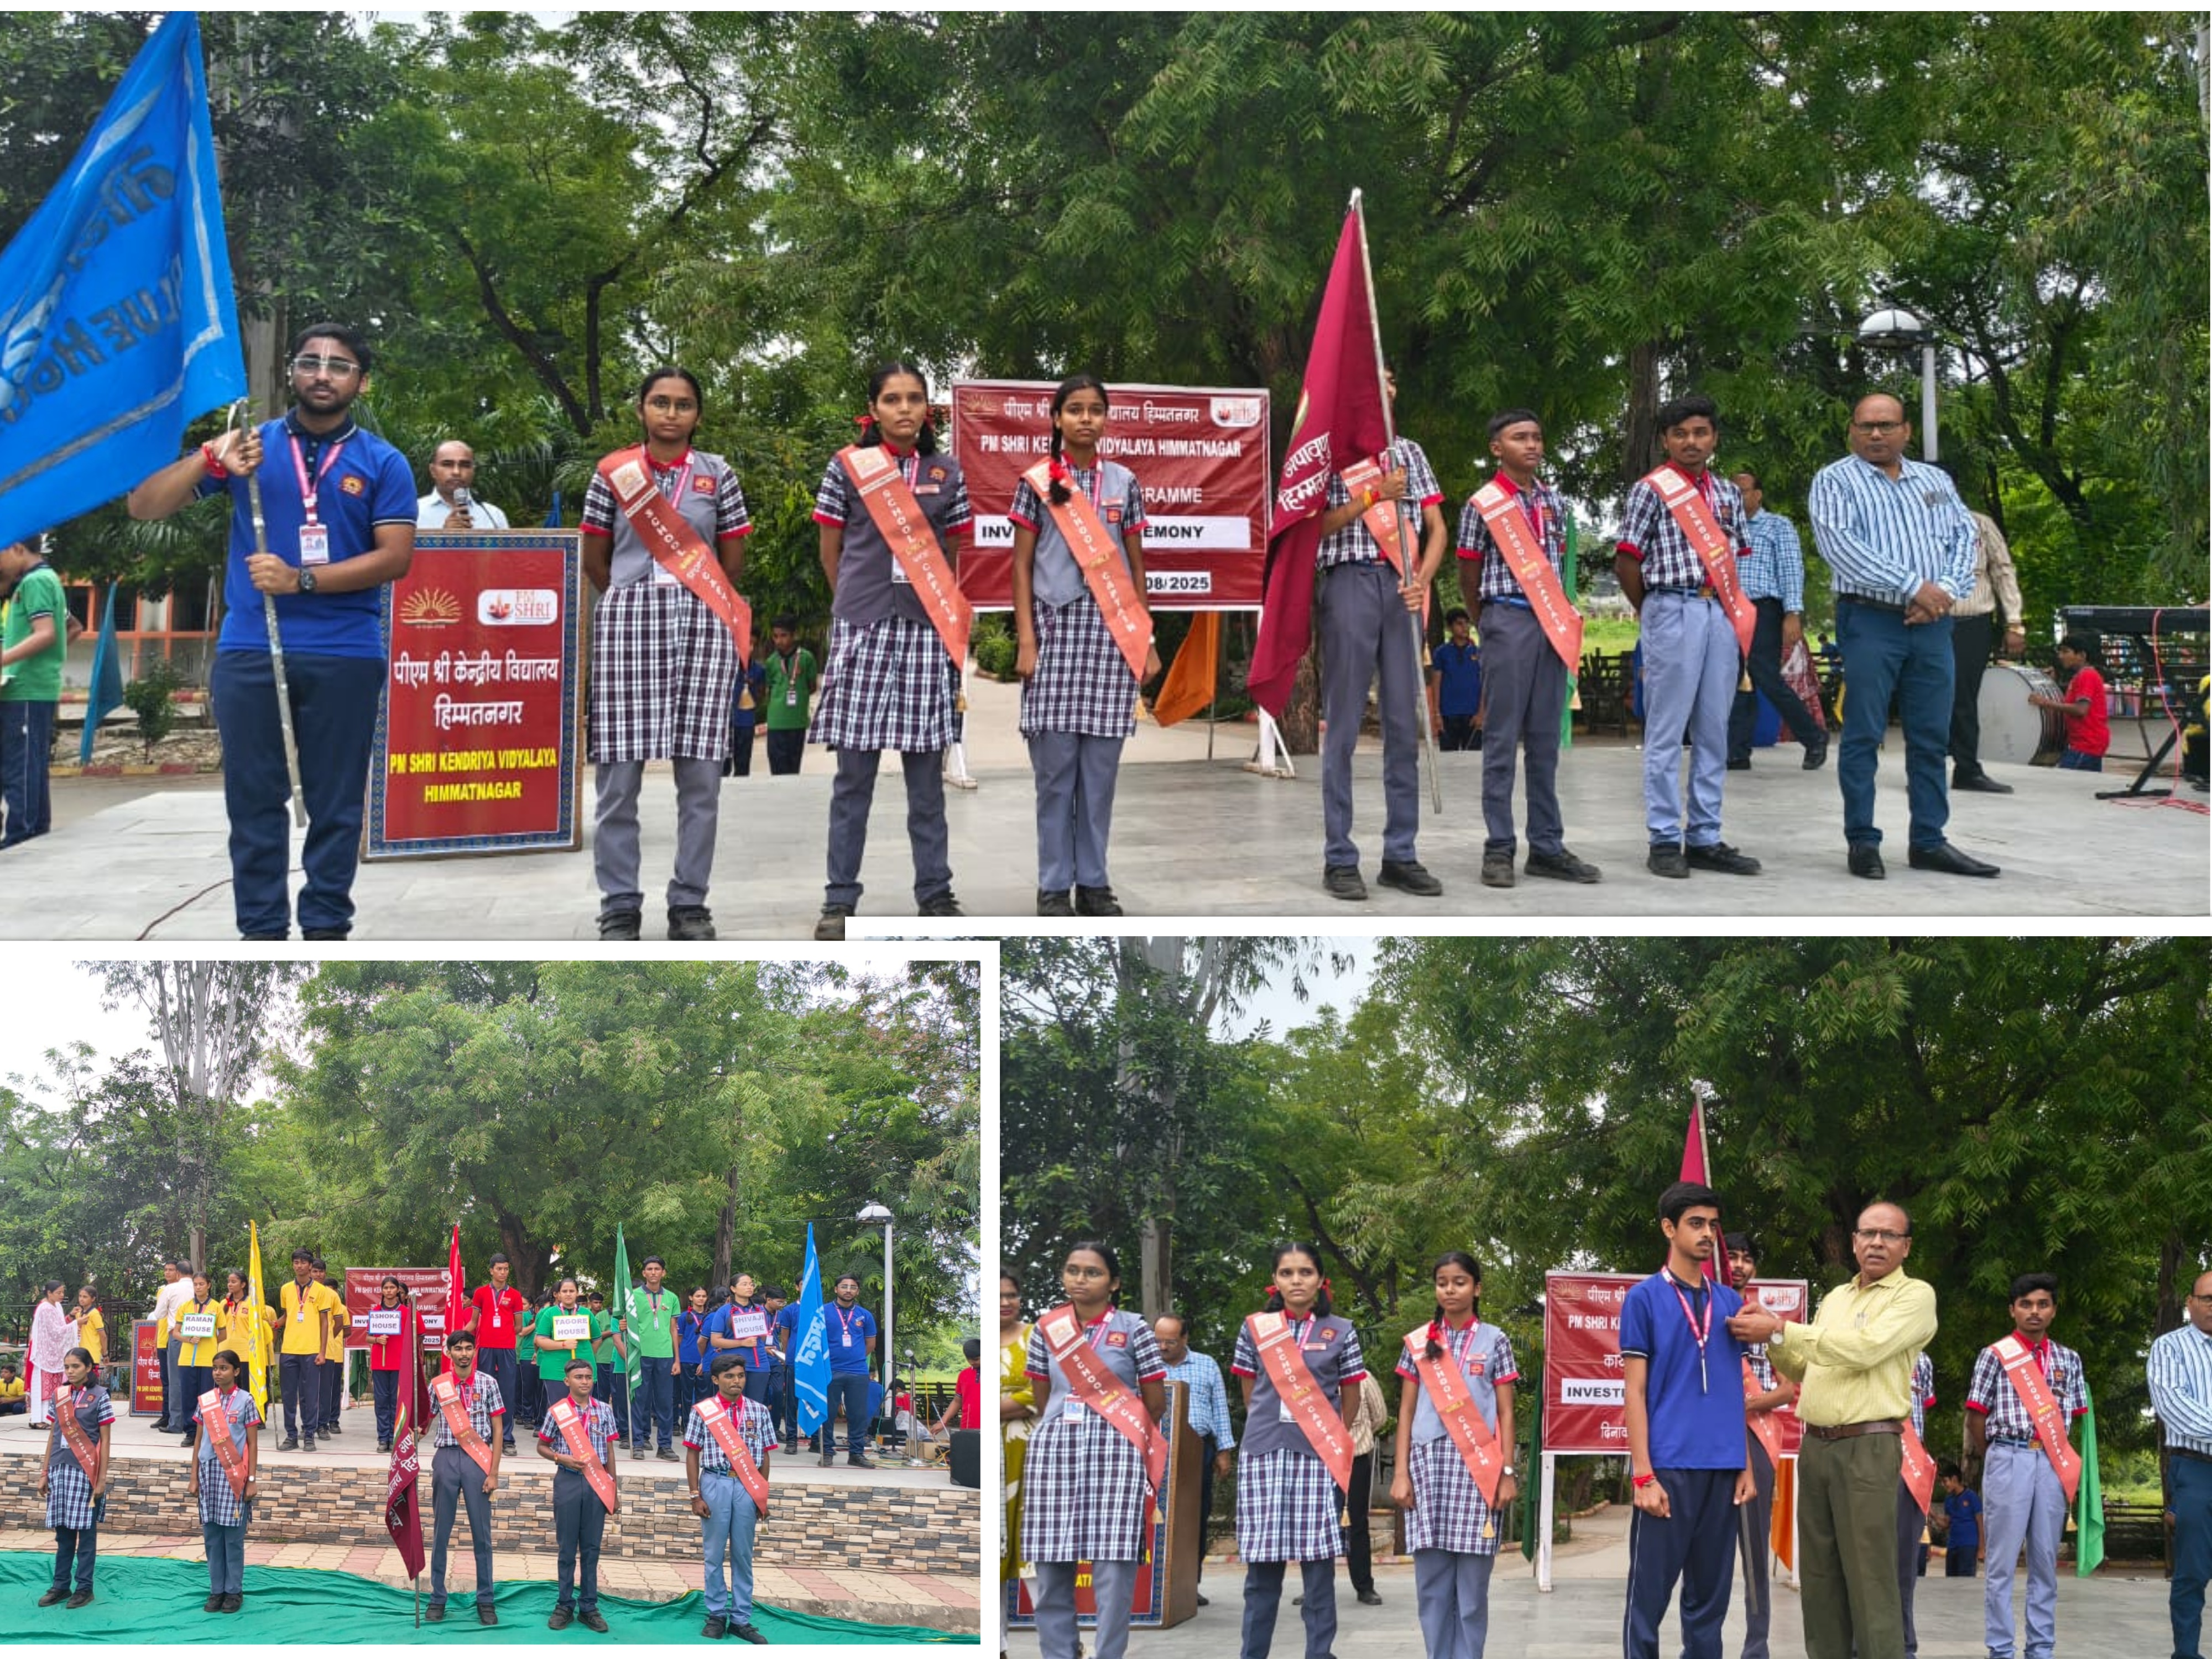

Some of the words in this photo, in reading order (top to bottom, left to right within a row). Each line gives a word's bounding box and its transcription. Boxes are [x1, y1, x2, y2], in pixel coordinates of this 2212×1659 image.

[980, 435, 999, 452] PM
[1001, 435, 1029, 453] SHRI
[1095, 437, 1155, 455] VIDYALAYA
[1159, 439, 1241, 457] HIMMATNAGAR
[883, 489, 916, 543] SCHOOL
[1144, 526, 1204, 538] EMONY
[515, 603, 550, 617] SHRI
[394, 651, 429, 689] पीएम
[434, 650, 450, 684] श्री
[454, 651, 501, 686] केन्द्रीय
[505, 649, 559, 683] विद्यालय
[434, 693, 523, 731] हिम्मतनगर
[390, 754, 406, 774] PM
[410, 753, 435, 773] SHRI
[439, 750, 495, 772] KENDRIYA
[498, 747, 557, 770] VIDYALAYA
[424, 781, 522, 803] HIMMATNAGAR
[1587, 1285, 1611, 1305] पीएम
[185, 1315, 215, 1323] RAMAN
[185, 1325, 212, 1333] HOUSE
[734, 1316, 764, 1324] SHIVAJI
[737, 1325, 764, 1334] HOUSE
[1568, 1314, 1582, 1329] PM
[1584, 1315, 1608, 1330] SHRI
[1072, 1354, 1108, 1395] SCHOOL
[1275, 1346, 1300, 1390] SCHOOL
[1568, 1387, 1625, 1397] INVESTI
[2020, 1368, 2044, 1406] SCHOOL
[569, 1426, 584, 1453] SCHOOL
[717, 1422, 736, 1448] SCHOOL
[223, 1446, 238, 1476] CAPTAIN
[740, 1459, 759, 1490] CAPTAIN
